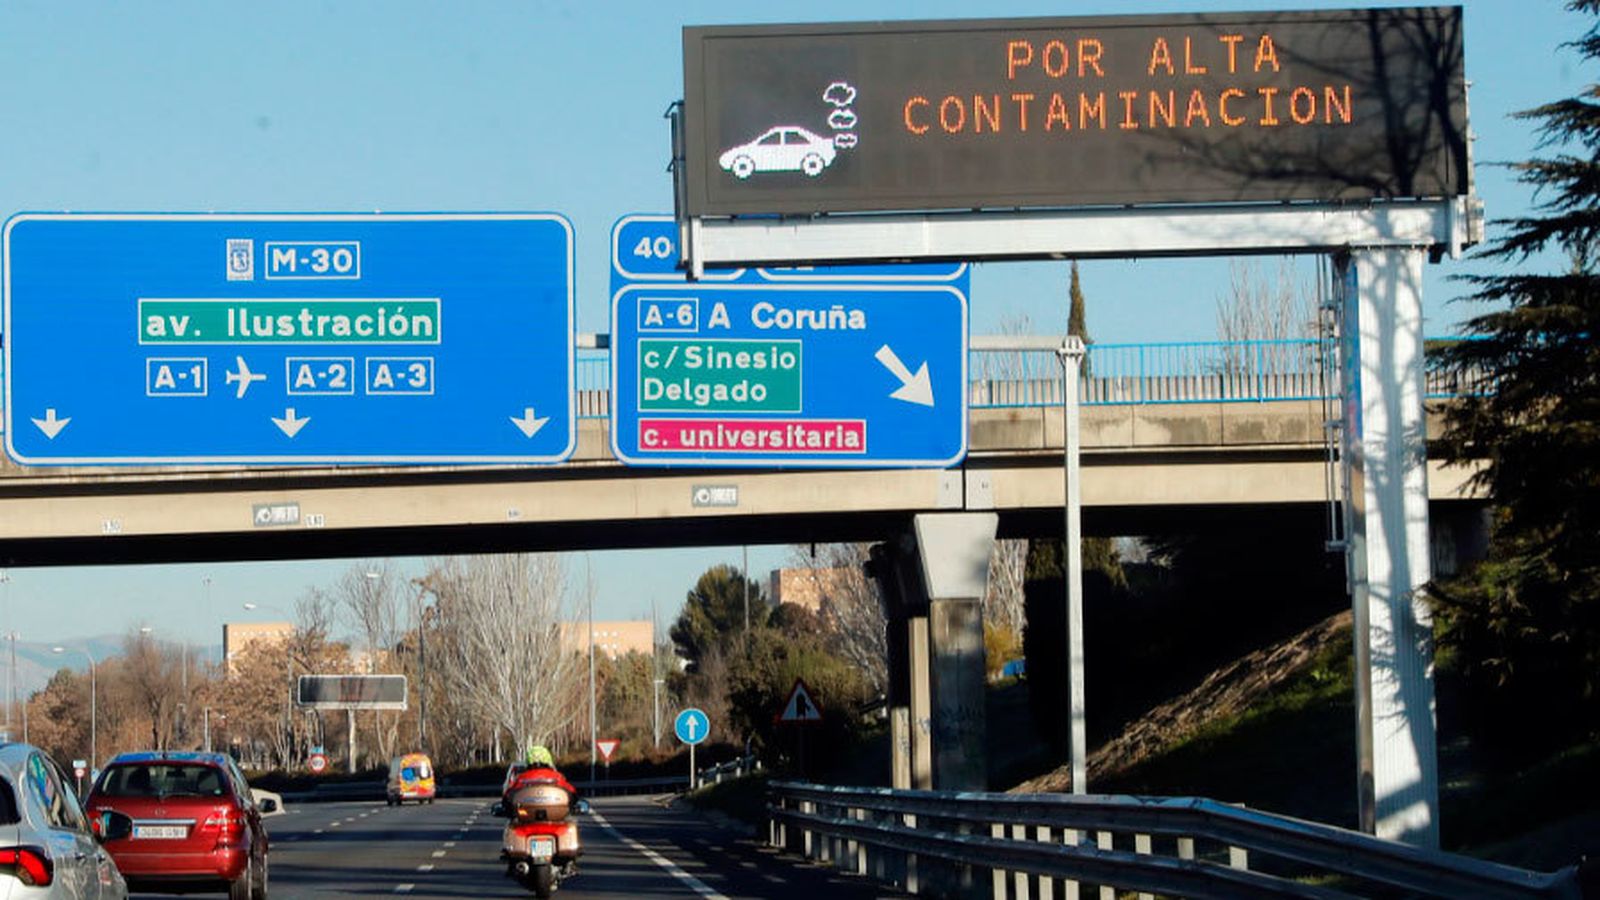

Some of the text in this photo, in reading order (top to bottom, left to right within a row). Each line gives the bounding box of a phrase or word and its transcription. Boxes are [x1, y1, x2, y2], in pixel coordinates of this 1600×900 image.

[1007, 33, 1281, 80] POR ALTA
[903, 84, 1353, 135] CONTAMINACION
[272, 247, 353, 273] M-30
[146, 306, 433, 338] av. Ilustración
[644, 302, 867, 330] A-6 A Coruña
[154, 364, 200, 388] A-1
[295, 364, 427, 388] A-2 A-3
[644, 378, 767, 406] Delgado
[644, 424, 860, 449] c. universitaria
